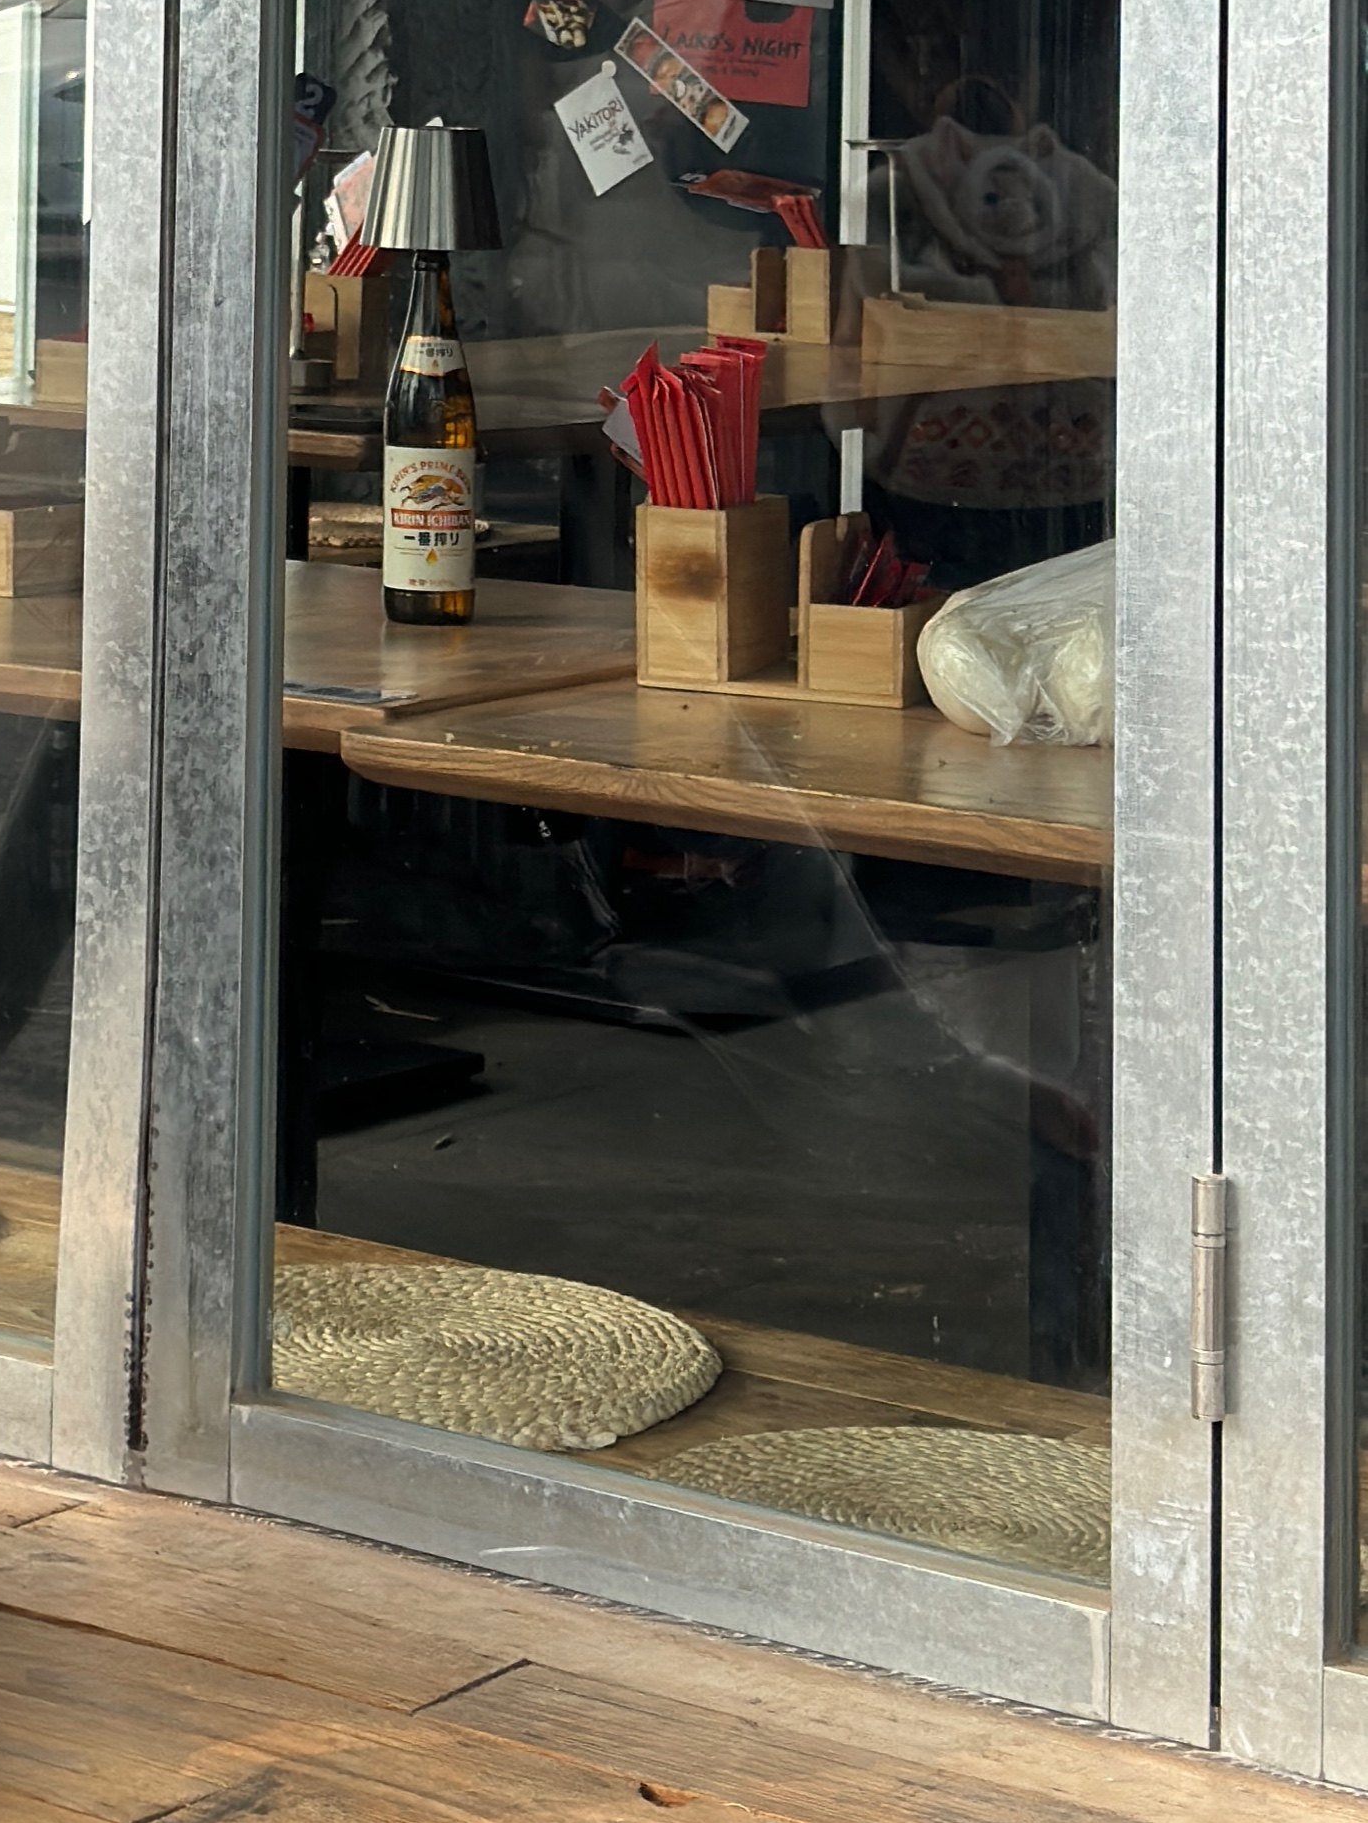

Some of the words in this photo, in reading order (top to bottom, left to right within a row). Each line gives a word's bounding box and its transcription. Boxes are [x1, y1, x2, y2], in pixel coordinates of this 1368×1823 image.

[743, 37, 802, 59] NIGHT
[569, 96, 625, 141] YAKITORI
[393, 513, 425, 527] KIRIN
[403, 531, 459, 547] 一番搾り
